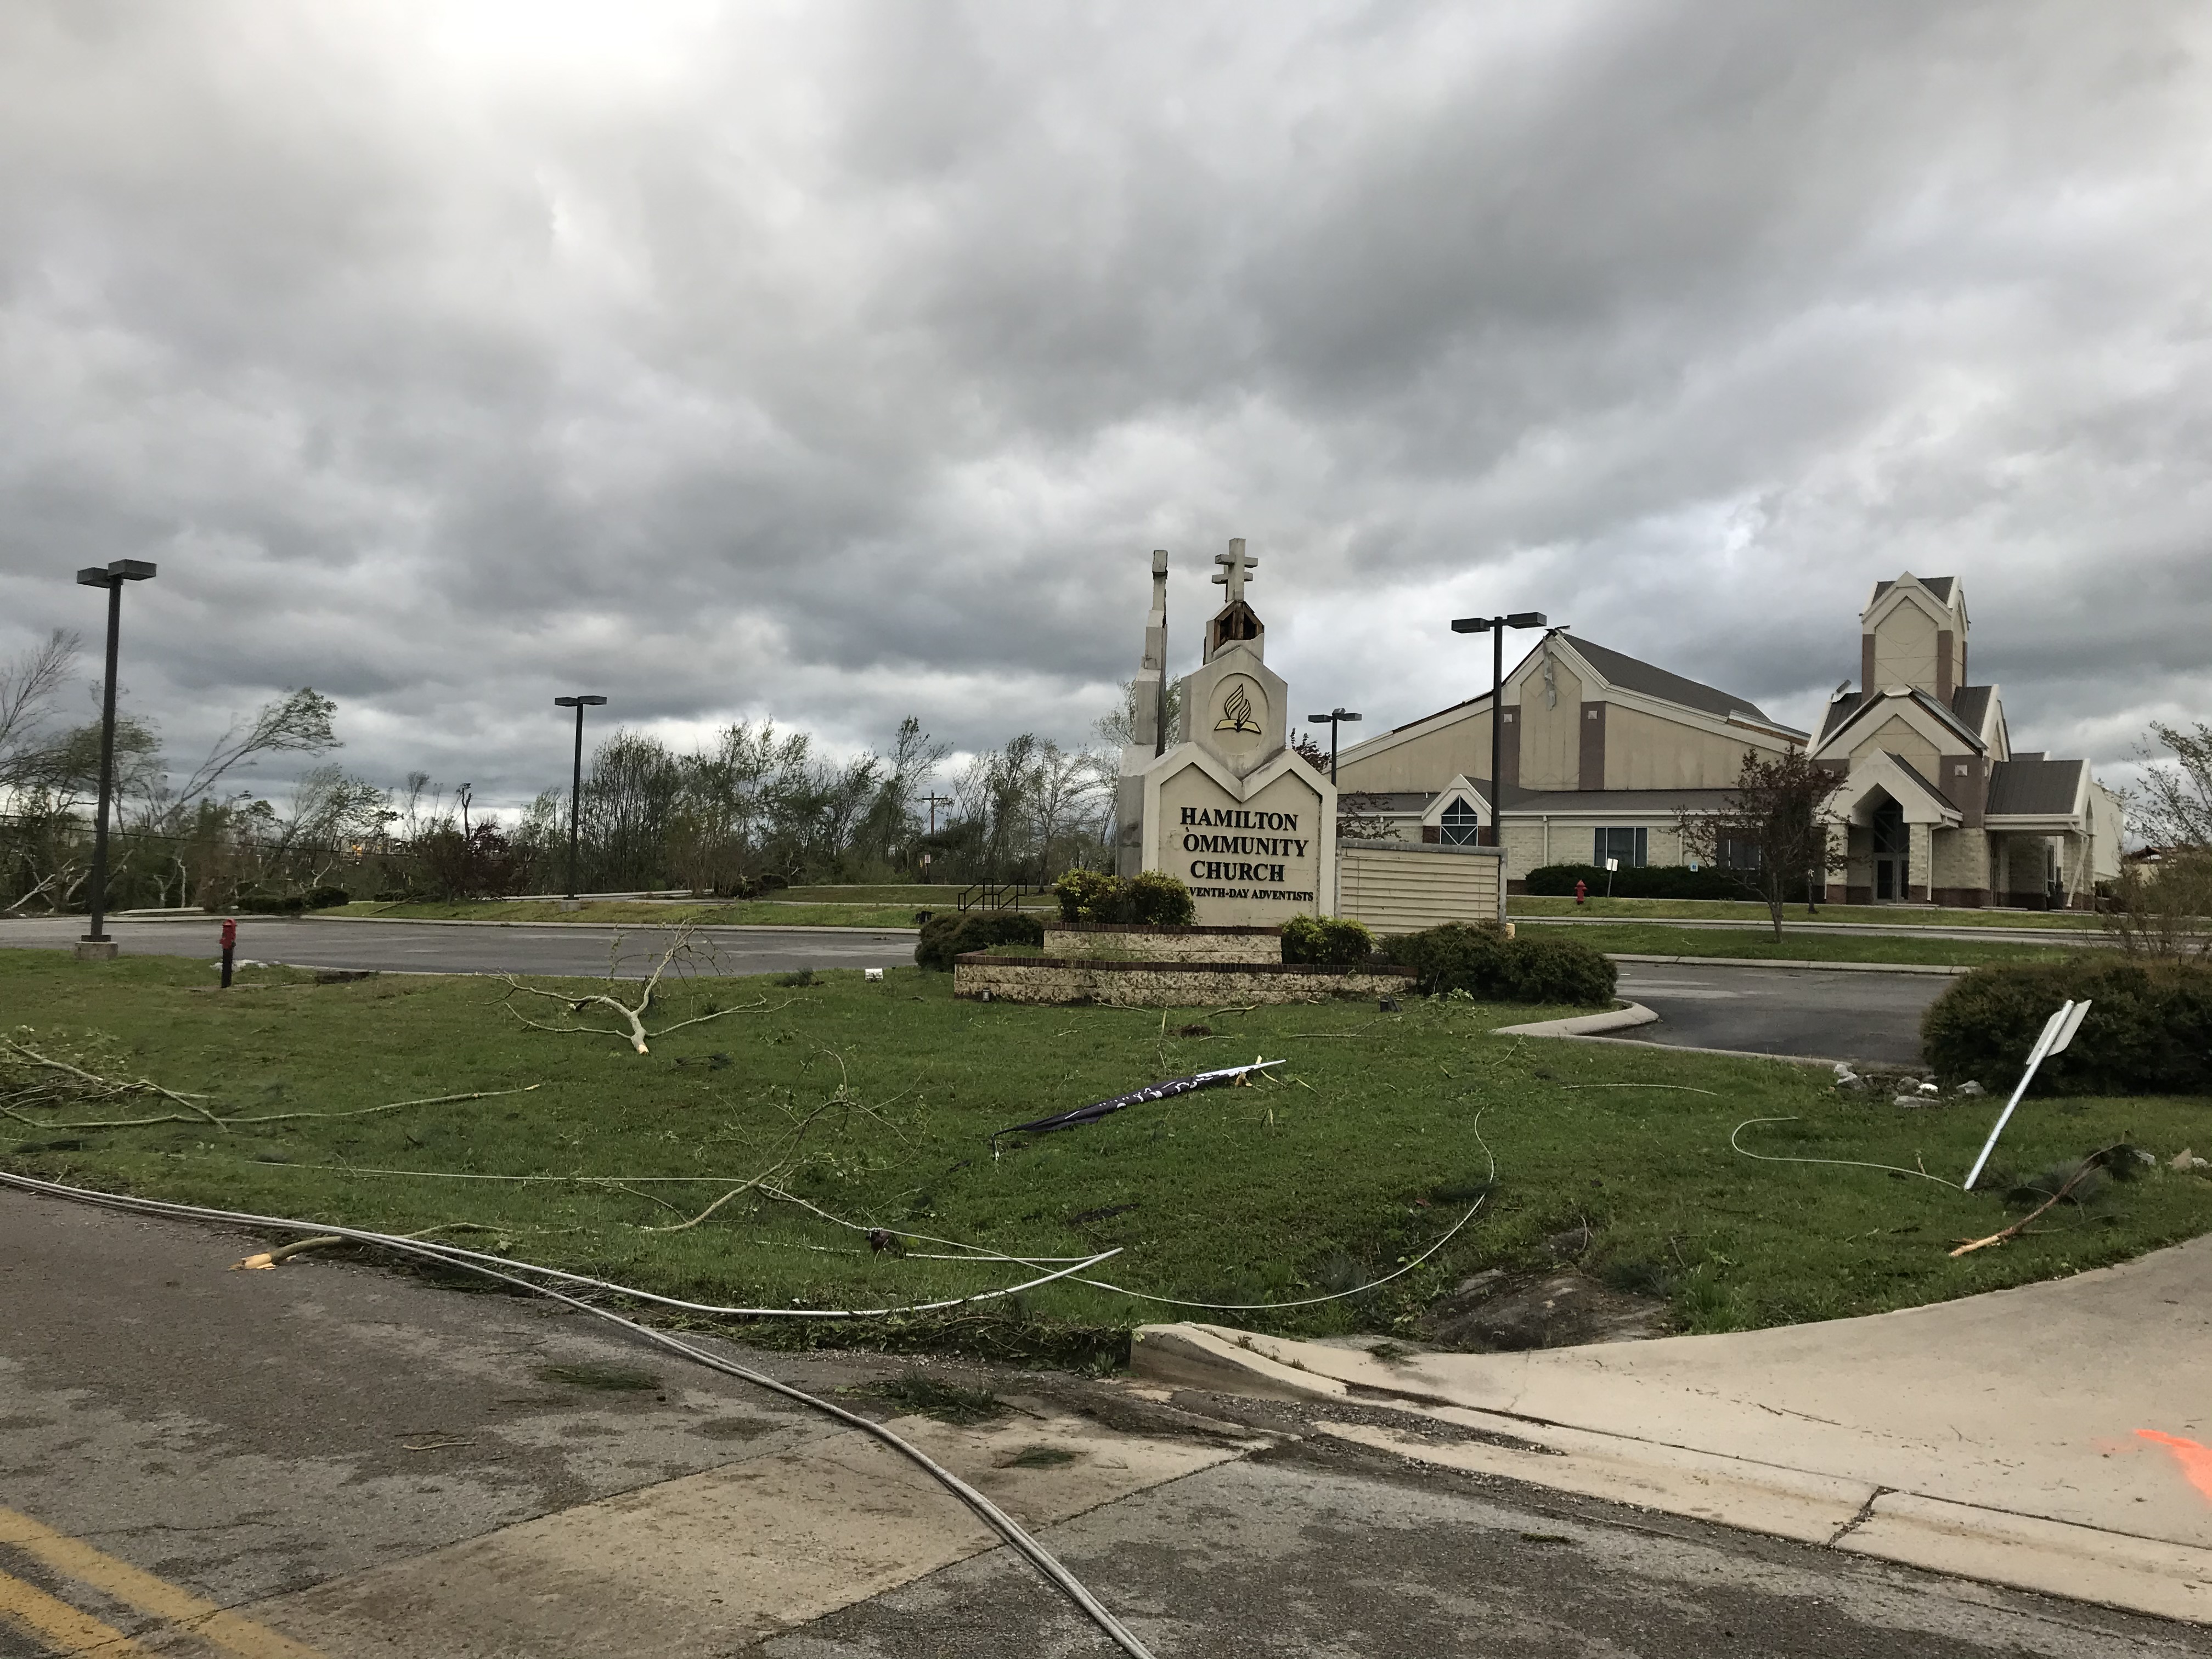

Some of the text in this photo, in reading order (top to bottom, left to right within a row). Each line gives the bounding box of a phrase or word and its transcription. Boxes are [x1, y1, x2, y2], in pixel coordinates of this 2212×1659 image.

[1180, 806, 1299, 832] HAMILTON
[1183, 833, 1309, 857] OMMUNITY
[1190, 860, 1285, 882] CHURCH
[1185, 886, 1314, 902] VENTH-DAY ADVENTISTS
